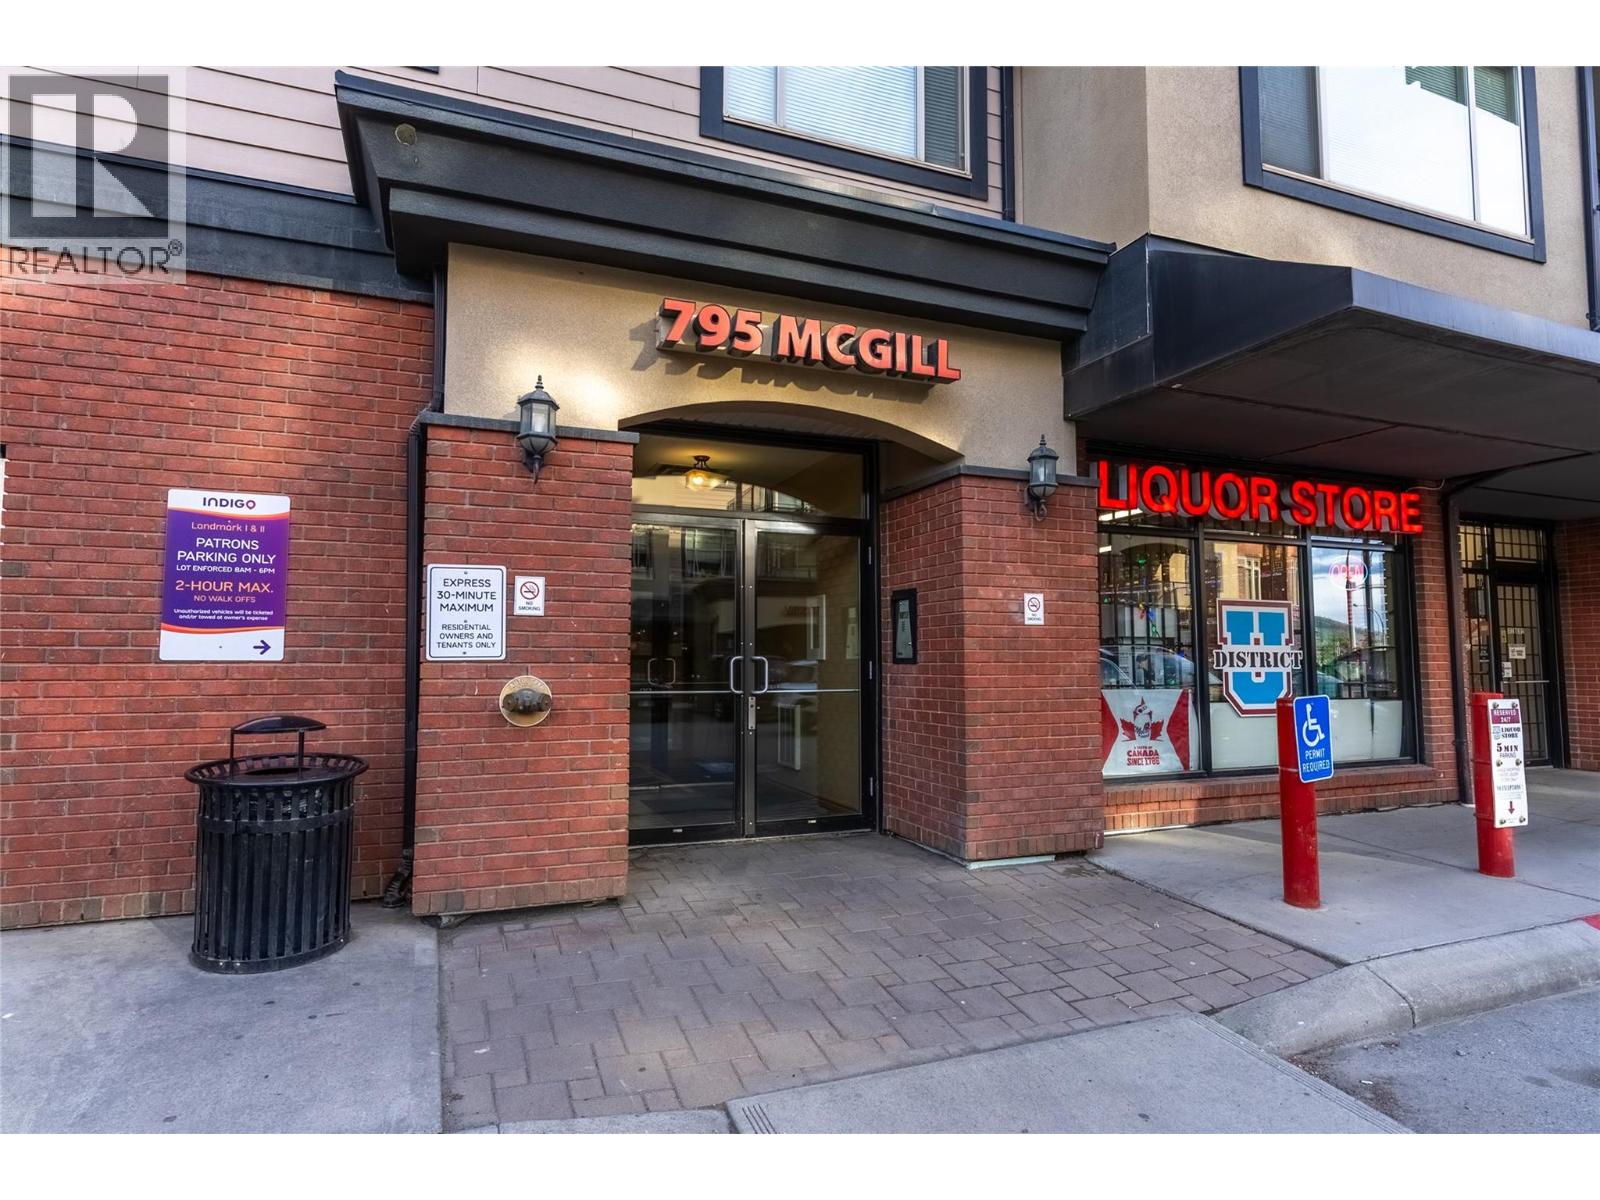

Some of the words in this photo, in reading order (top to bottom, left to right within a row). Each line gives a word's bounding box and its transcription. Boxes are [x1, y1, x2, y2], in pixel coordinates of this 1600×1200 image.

[661, 297, 764, 352] 795
[773, 313, 961, 381] MCGILL
[1099, 460, 1279, 521] LIQUOR
[1291, 480, 1423, 533] STORE
[202, 497, 256, 510] INDIGO
[191, 521, 242, 532] Landmark
[250, 524, 257, 533] &
[195, 537, 259, 550] PATRONS
[177, 550, 237, 563] PARKING
[241, 553, 276, 564] ONLY
[192, 565, 232, 573] ENFORCED
[175, 579, 233, 592] 2-HOUR
[238, 582, 274, 593] MAX.
[443, 578, 491, 588] EXPRESS
[437, 590, 497, 600] 30-MINUTE
[439, 603, 494, 612] MAXIMUM
[441, 623, 492, 631] RESIDENTIAL
[439, 632, 475, 640] OWNERS
[476, 632, 493, 640] AND
[437, 641, 473, 649] TENANTS
[475, 641, 496, 649] ONLY
[1213, 650, 1303, 669] DISTRICT
[1496, 742, 1503, 752] 5
[1503, 744, 1519, 752] MIN
[1126, 749, 1159, 757] CANADA
[1305, 748, 1326, 760] PERMIT
[1126, 757, 1144, 766] SINCE
[1302, 759, 1331, 773] REQUIRED
